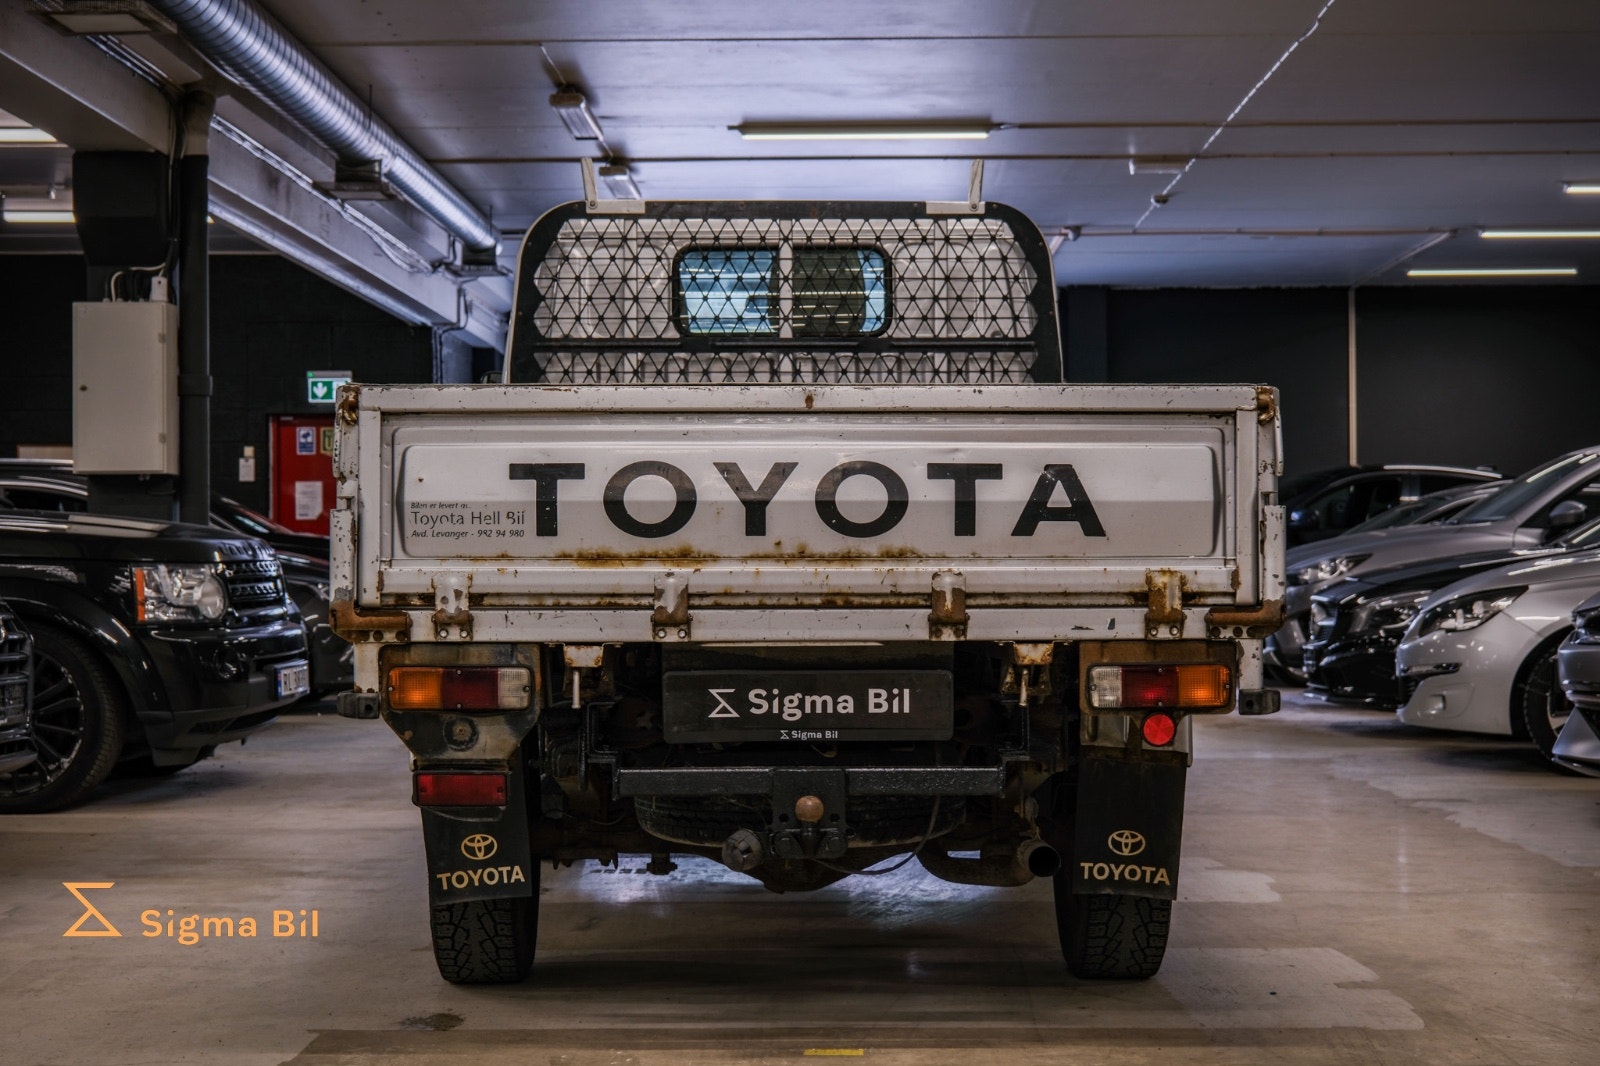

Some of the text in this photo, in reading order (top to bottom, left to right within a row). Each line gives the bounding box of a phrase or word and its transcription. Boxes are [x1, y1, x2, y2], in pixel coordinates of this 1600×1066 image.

[438, 501, 458, 509] levert
[509, 460, 1106, 538] TOYOTA
[410, 511, 465, 530] Toyota
[471, 510, 500, 525] Hell
[431, 529, 469, 540] Levanger
[495, 529, 506, 538] 94
[509, 529, 525, 538] 980
[748, 688, 911, 722] Sigma Bil
[791, 730, 839, 741] Sigma Bil
[436, 865, 526, 891] TOYOTA
[1080, 862, 1171, 886] TOYOTA
